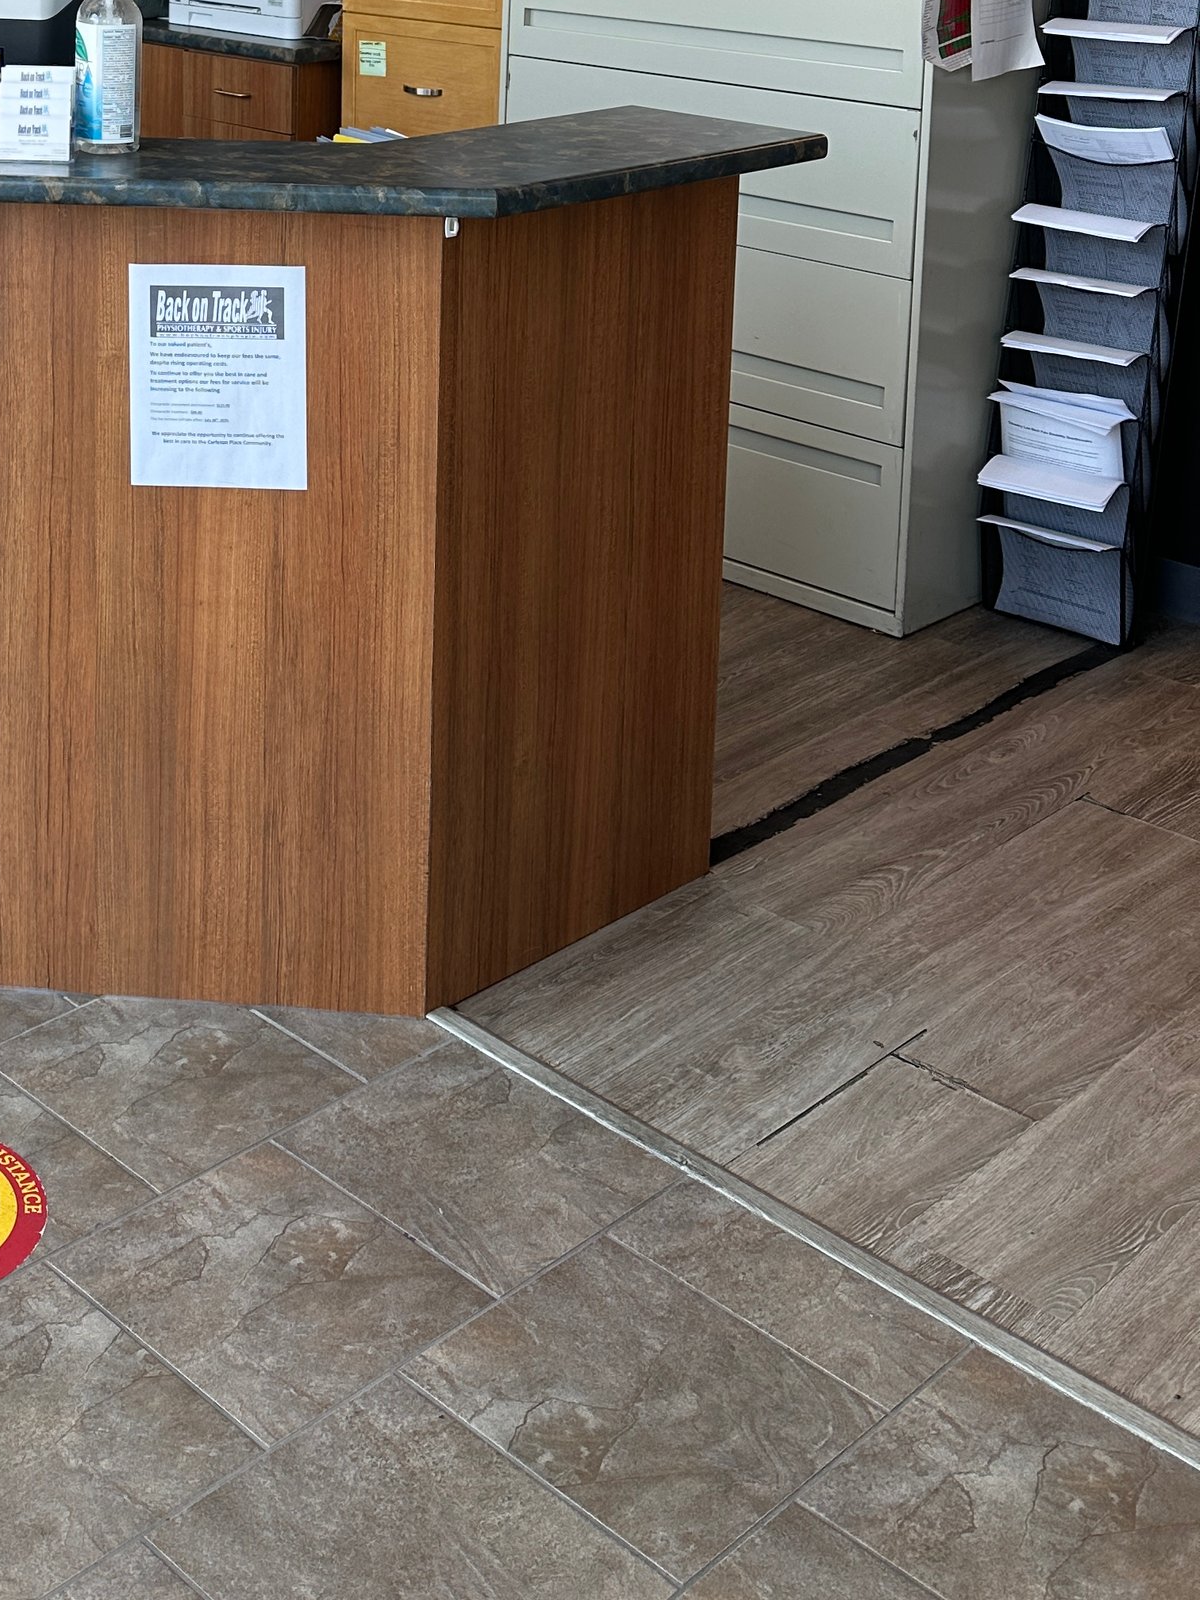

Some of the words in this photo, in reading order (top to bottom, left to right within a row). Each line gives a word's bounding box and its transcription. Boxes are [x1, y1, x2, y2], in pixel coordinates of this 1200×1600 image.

[156, 290, 190, 322] Back
[192, 297, 208, 322] on
[212, 290, 249, 323] Track
[157, 324, 214, 332] PHYSIOTHERAPY
[223, 326, 250, 334] SPORTS
[252, 326, 277, 334] INJURY
